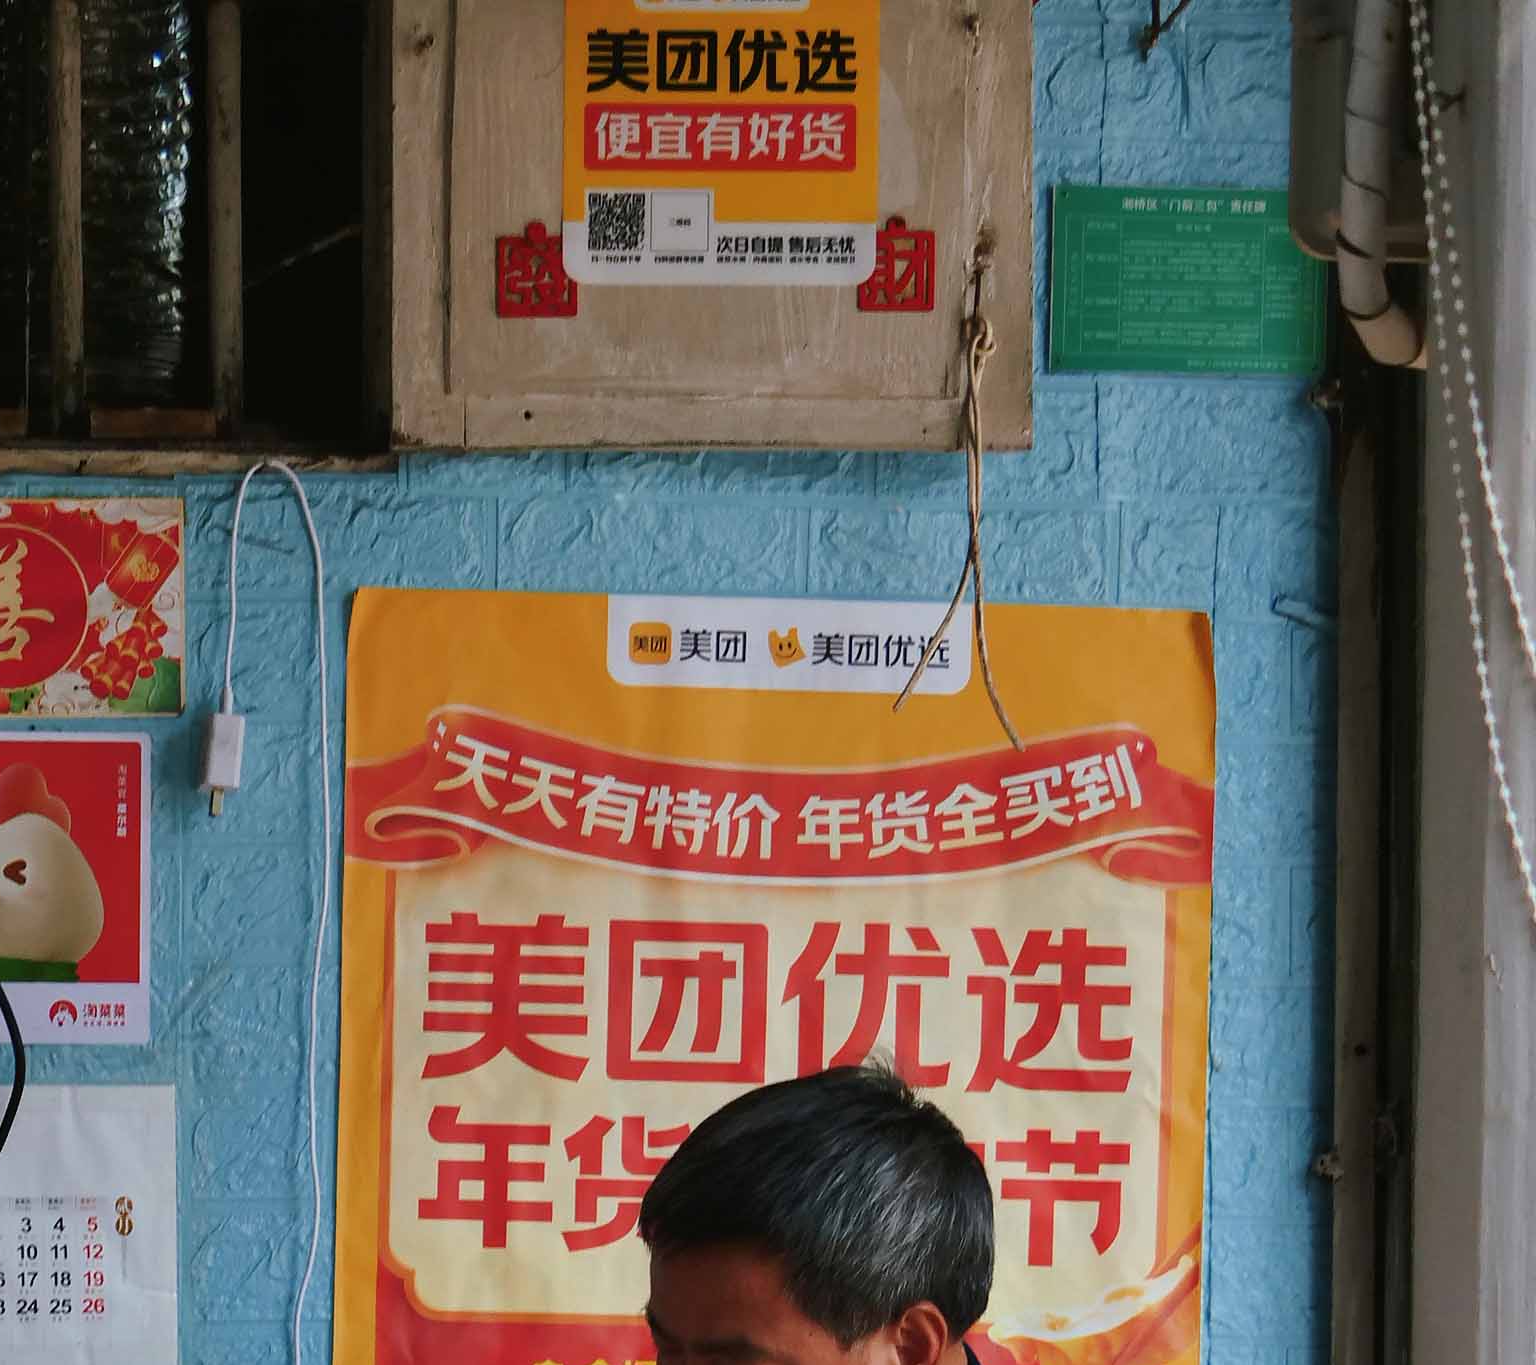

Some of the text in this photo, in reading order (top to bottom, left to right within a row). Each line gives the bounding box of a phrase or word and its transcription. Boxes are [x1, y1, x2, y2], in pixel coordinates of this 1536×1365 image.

[587, 28, 857, 93] 美团优选
[595, 112, 846, 161] 便宜有好货
[679, 628, 748, 663] 美团
[811, 631, 951, 669] 美团优选
[433, 734, 1143, 861] 天天有特价 年货全买到
[421, 911, 1133, 1093] 美团优选
[417, 1104, 1131, 1267] 年货节
[21, 1216, 32, 1233] 3
[52, 1216, 66, 1233] 4
[87, 1216, 98, 1232] 5
[16, 1243, 38, 1261] 10
[50, 1243, 68, 1261] 11
[82, 1243, 104, 1260] 12
[17, 1271, 39, 1288] 17
[50, 1270, 72, 1288] 18
[83, 1270, 105, 1287] 19
[16, 1298, 39, 1316] 24
[49, 1298, 72, 1315] 25
[82, 1298, 105, 1314] 26
